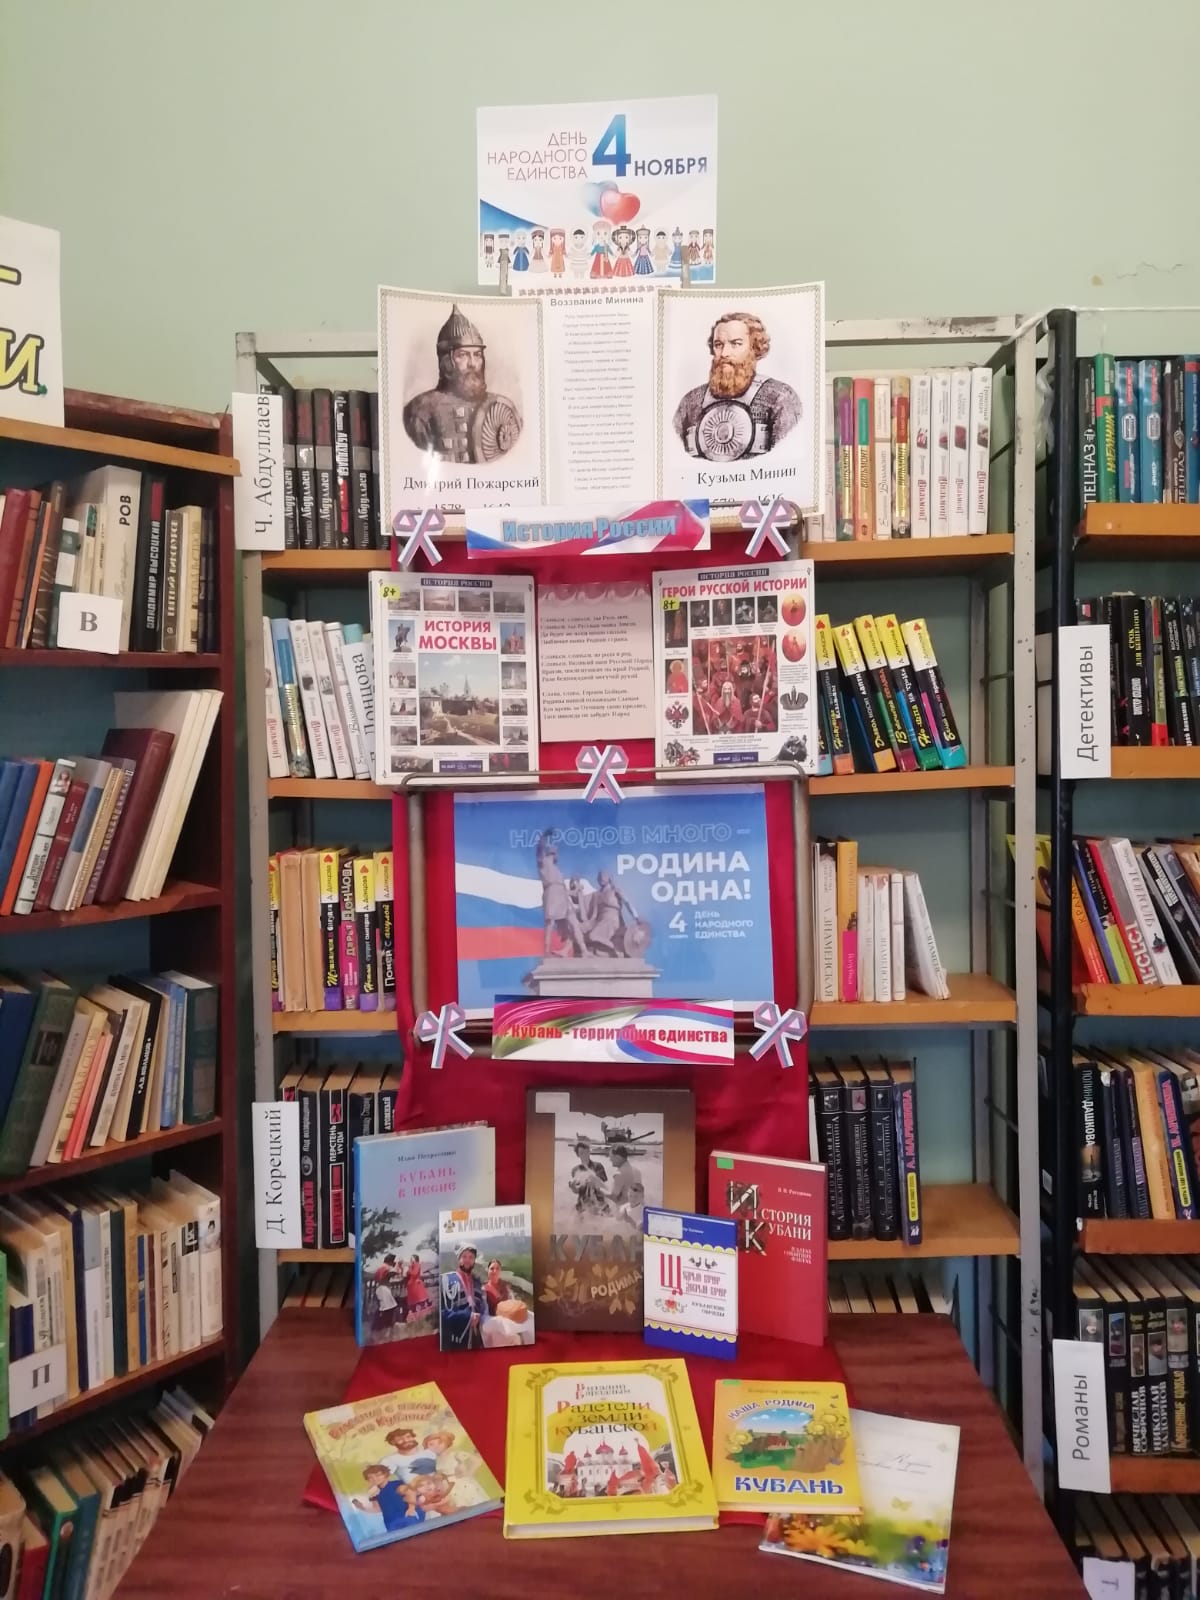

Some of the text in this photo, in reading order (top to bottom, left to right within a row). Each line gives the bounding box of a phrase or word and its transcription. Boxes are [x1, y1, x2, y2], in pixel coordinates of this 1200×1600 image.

[547, 131, 588, 147] ДЕНЬ
[591, 113, 708, 178] 4 НОЯБРЯ
[487, 148, 588, 166] НАРОДНОГО
[507, 165, 588, 182] ЕДИНСТВА
[605, 295, 644, 305] Минина
[1105, 411, 1116, 473] НАЕМНИК
[253, 395, 278, 534] Ч. Абдуллаев
[697, 467, 797, 487] Кузьма Минин
[1084, 443, 1097, 508] ПЕЦНАЗ
[301, 470, 313, 519] Абдуллаев
[320, 472, 332, 520] Абдуллаев
[358, 472, 371, 520] Абдуллаев
[466, 475, 540, 492] Пожарский
[119, 495, 131, 526] РОВ
[502, 515, 677, 543] История России
[382, 587, 397, 599] 8+
[662, 578, 808, 599] ГЕРОИ РУССКОЙ ИСТОРИИ
[80, 611, 98, 632] В
[424, 620, 491, 633] ИСТОРИЯ
[418, 635, 497, 651] МОСКВЫ
[1077, 645, 1100, 762] Детективы
[509, 822, 733, 848] НАРОДОВ МНОГО
[616, 851, 751, 878] РОДИНА
[341, 860, 356, 921] Донцова
[651, 879, 752, 905] ОДНА!
[1071, 882, 1087, 924] КРАМ
[668, 912, 689, 933] 4
[694, 911, 721, 919] ДЕНЬ
[694, 919, 754, 929] НАРОДНОГО
[694, 930, 747, 939] ЕДИНСТВА
[383, 950, 395, 987] Покер
[658, 1027, 729, 1044] единства
[1082, 1069, 1097, 1147] ПОЛИНА ДАШКОВА
[264, 1108, 286, 1235] Д. Корецкий
[457, 1213, 527, 1234] КРАСНОДАРСКИЙ
[550, 1234, 644, 1263] КУБАН
[591, 1268, 644, 1298] РОДИМА
[32, 1364, 50, 1389] П
[728, 1398, 817, 1420] НАША РОДИНА
[1072, 1374, 1091, 1461] Романы
[1131, 1391, 1140, 1452] ВЯЧЕСЛАВ
[1138, 1385, 1148, 1452] СОФРОНОВ
[1151, 1384, 1161, 1452] НИКОЛАЙ
[735, 1476, 844, 1495] КУБАНЬ
